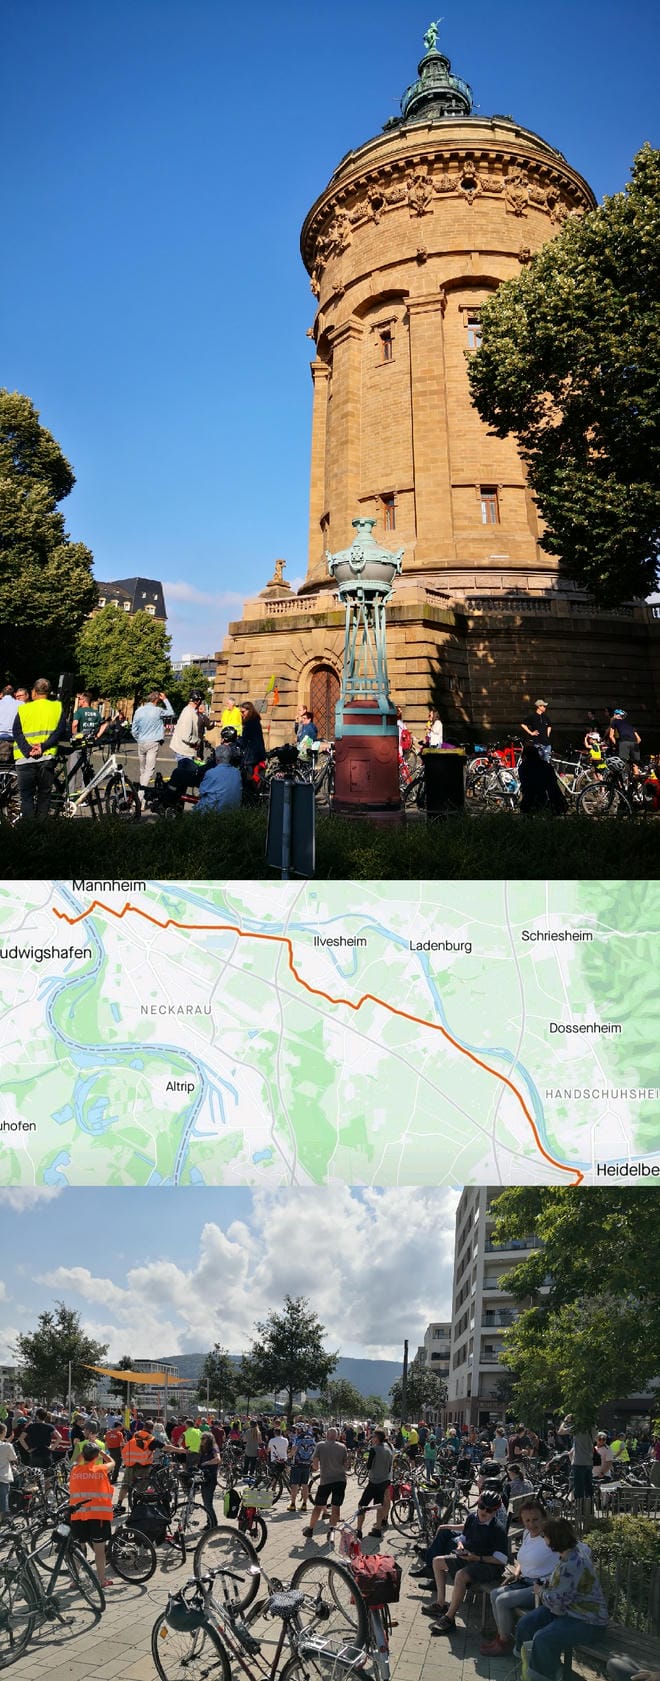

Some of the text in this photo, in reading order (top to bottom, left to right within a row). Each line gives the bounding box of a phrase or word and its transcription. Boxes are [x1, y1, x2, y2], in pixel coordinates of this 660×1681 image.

[72, 880, 146, 892] Mannheim
[314, 936, 367, 947] Ilvesheim
[521, 930, 593, 942] Schriesheim
[409, 940, 472, 954] Ladenburg
[140, 1005, 212, 1015] NECKARAU
[549, 1022, 622, 1034] Dossenheim
[166, 1081, 195, 1094] Altrip
[598, 1163, 660, 1177] Heidelbe
